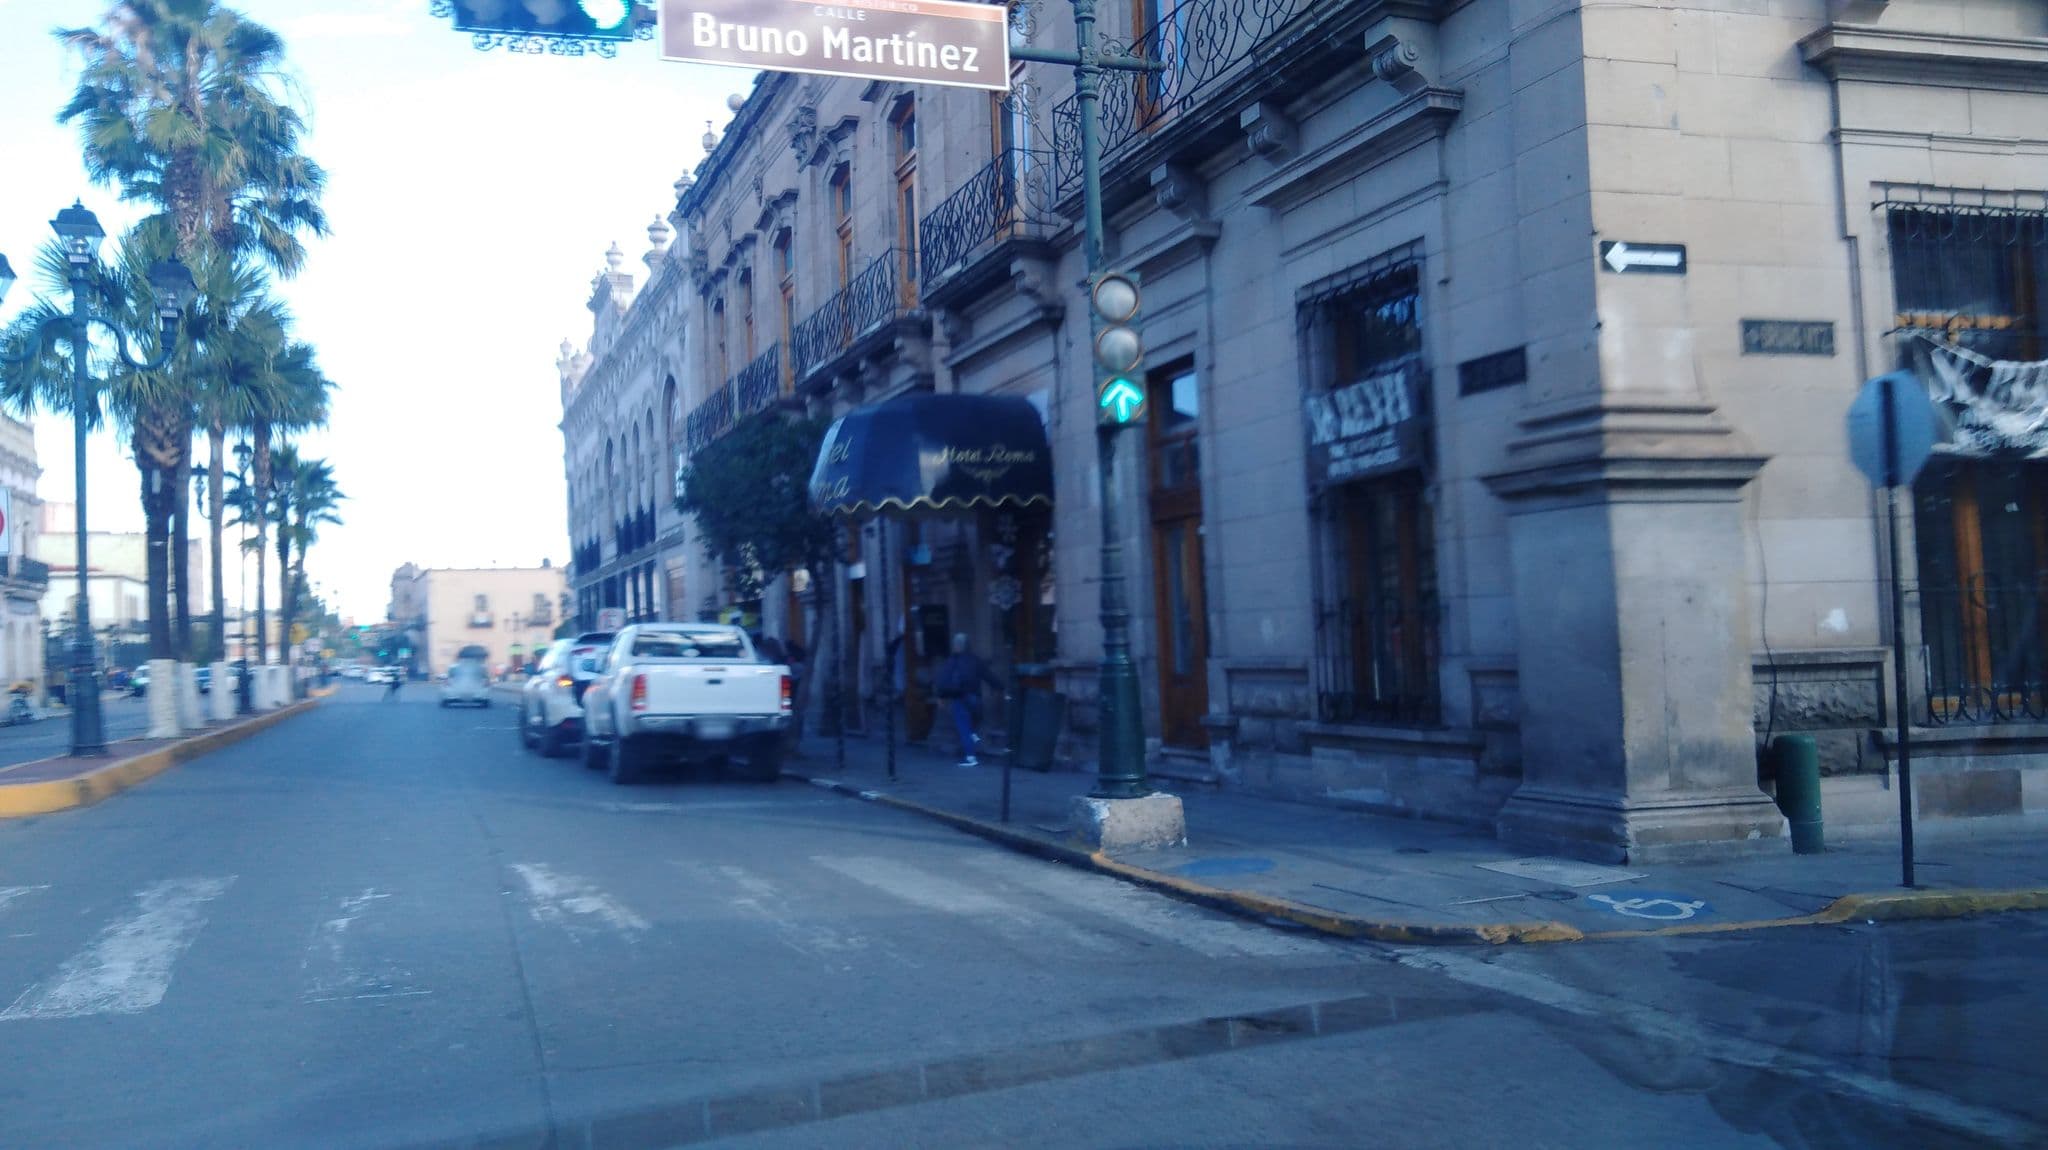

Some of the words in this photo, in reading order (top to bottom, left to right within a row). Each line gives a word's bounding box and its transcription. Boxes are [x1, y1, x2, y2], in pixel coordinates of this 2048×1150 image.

[814, 6, 866, 20] CALLE
[692, 12, 808, 56] Bruno
[822, 25, 979, 72] Martínez
